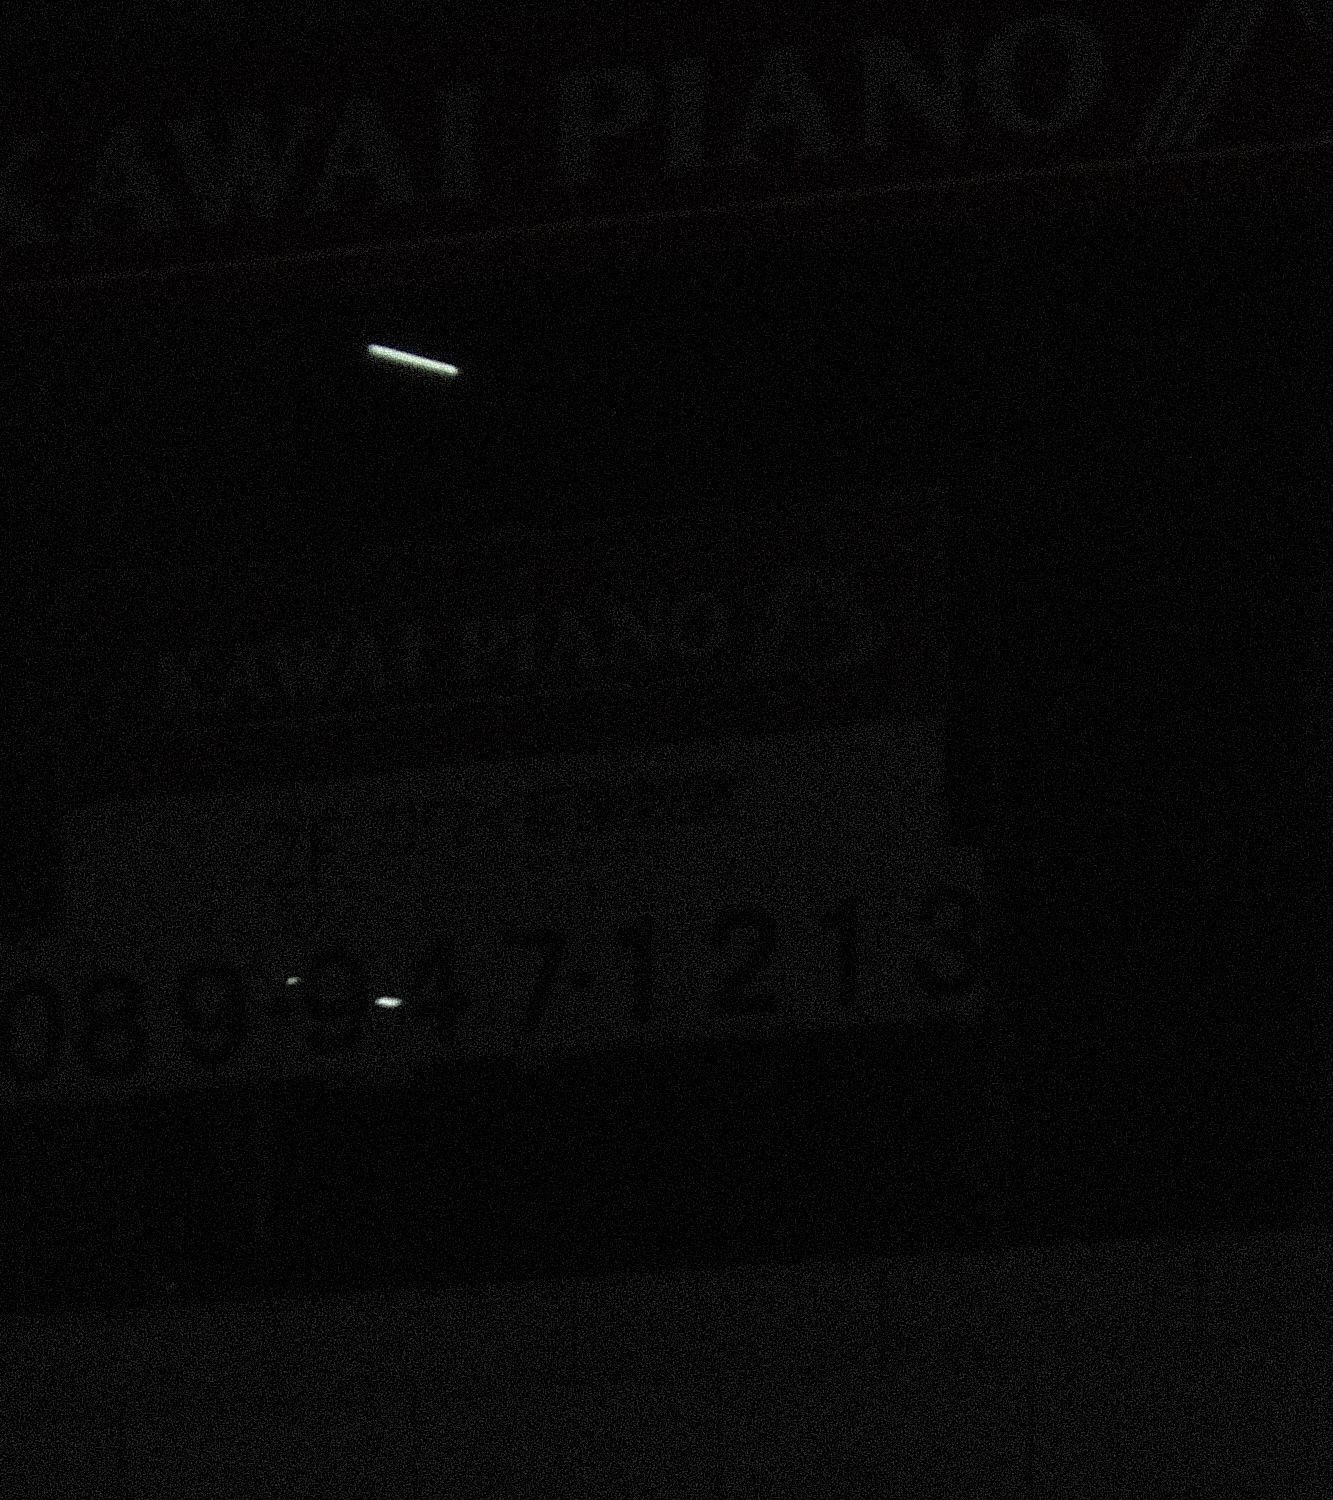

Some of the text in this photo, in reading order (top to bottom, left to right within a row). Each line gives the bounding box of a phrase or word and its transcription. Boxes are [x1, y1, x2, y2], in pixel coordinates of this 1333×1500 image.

[554, 10, 1109, 188] PIANO
[156, 589, 730, 714] KAWAI PIANO
